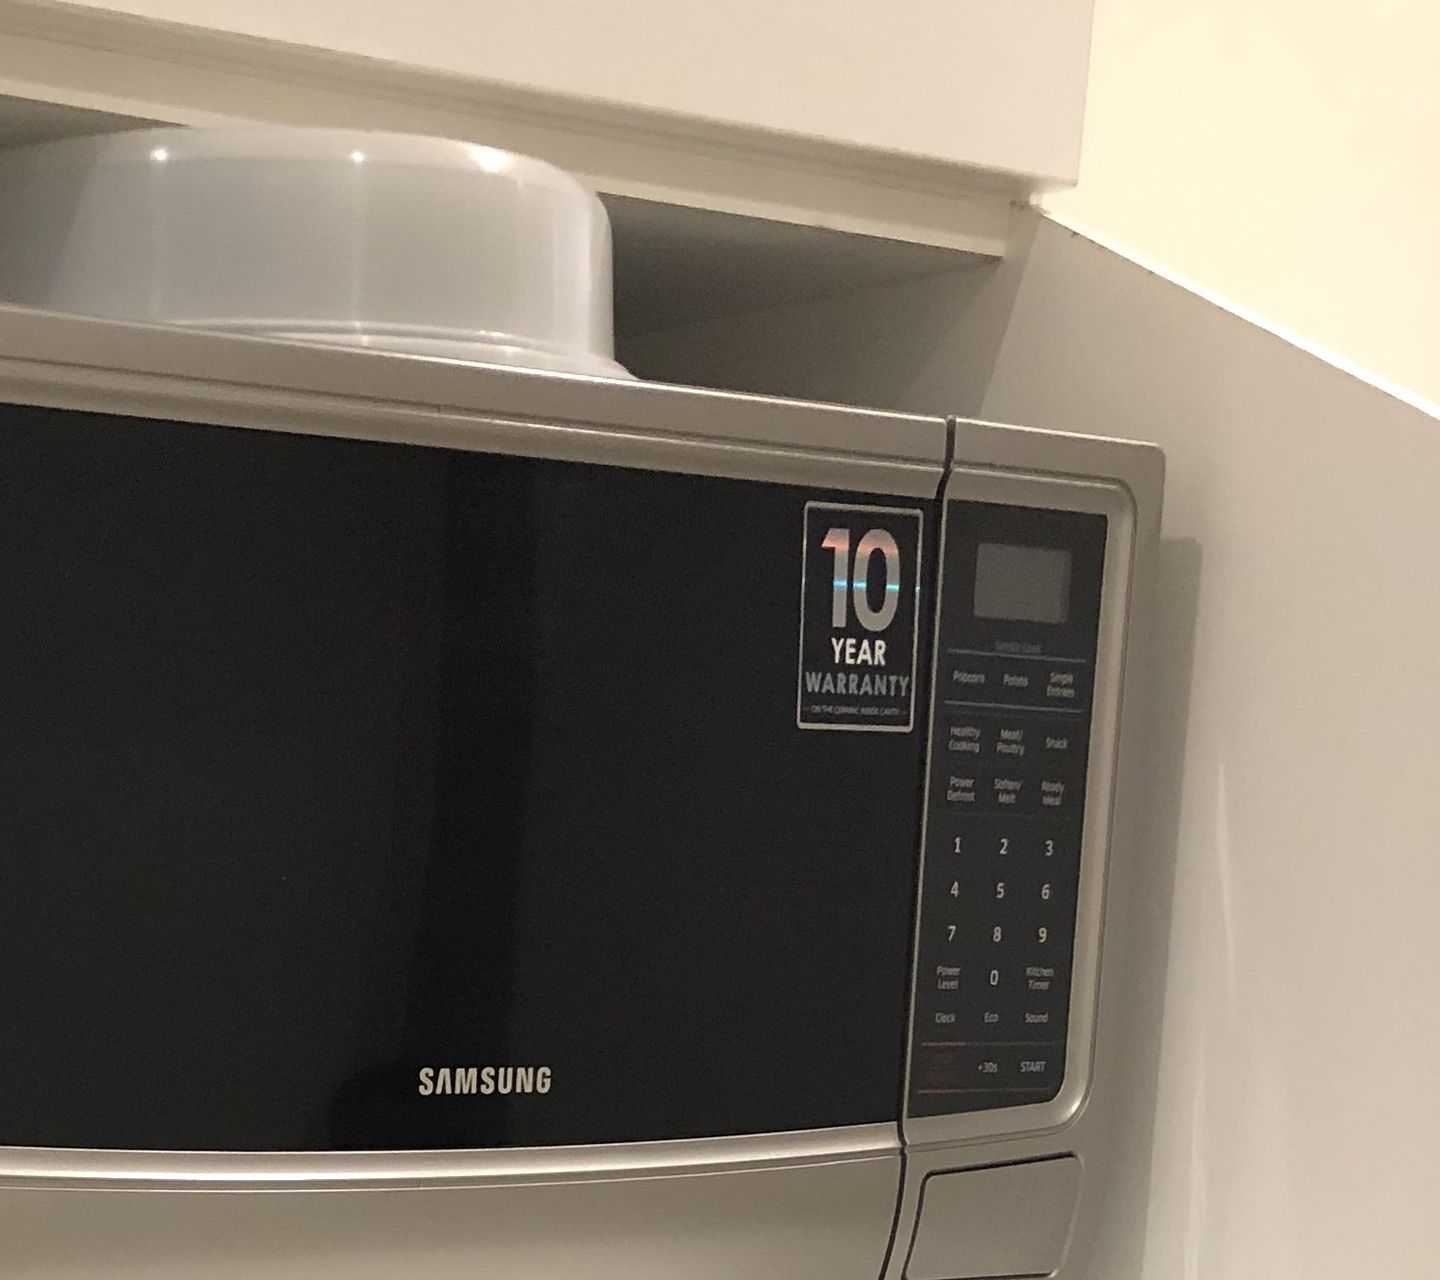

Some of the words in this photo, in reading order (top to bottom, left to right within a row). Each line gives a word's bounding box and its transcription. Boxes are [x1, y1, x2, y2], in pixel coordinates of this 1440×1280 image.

[821, 528, 900, 632] 10
[831, 637, 886, 666] YEAR
[805, 671, 910, 697] WARRANTY
[949, 776, 974, 789] Power
[954, 836, 961, 853] 1
[999, 838, 1008, 855] 2
[1045, 840, 1054, 856] 3
[950, 881, 959, 898] 4
[996, 882, 1005, 898] 5
[1041, 883, 1050, 900] 6
[947, 925, 956, 941] 7
[992, 926, 1002, 942] 8
[1038, 927, 1047, 943] 9
[936, 965, 961, 976] Power
[990, 969, 999, 986] 0
[938, 978, 958, 990] Level
[935, 1012, 956, 1024] Clock
[984, 1012, 999, 1024] Eco
[1025, 1011, 1048, 1024] Sound
[1020, 1061, 1047, 1073] START
[418, 1066, 552, 1096] SAMSUNG
